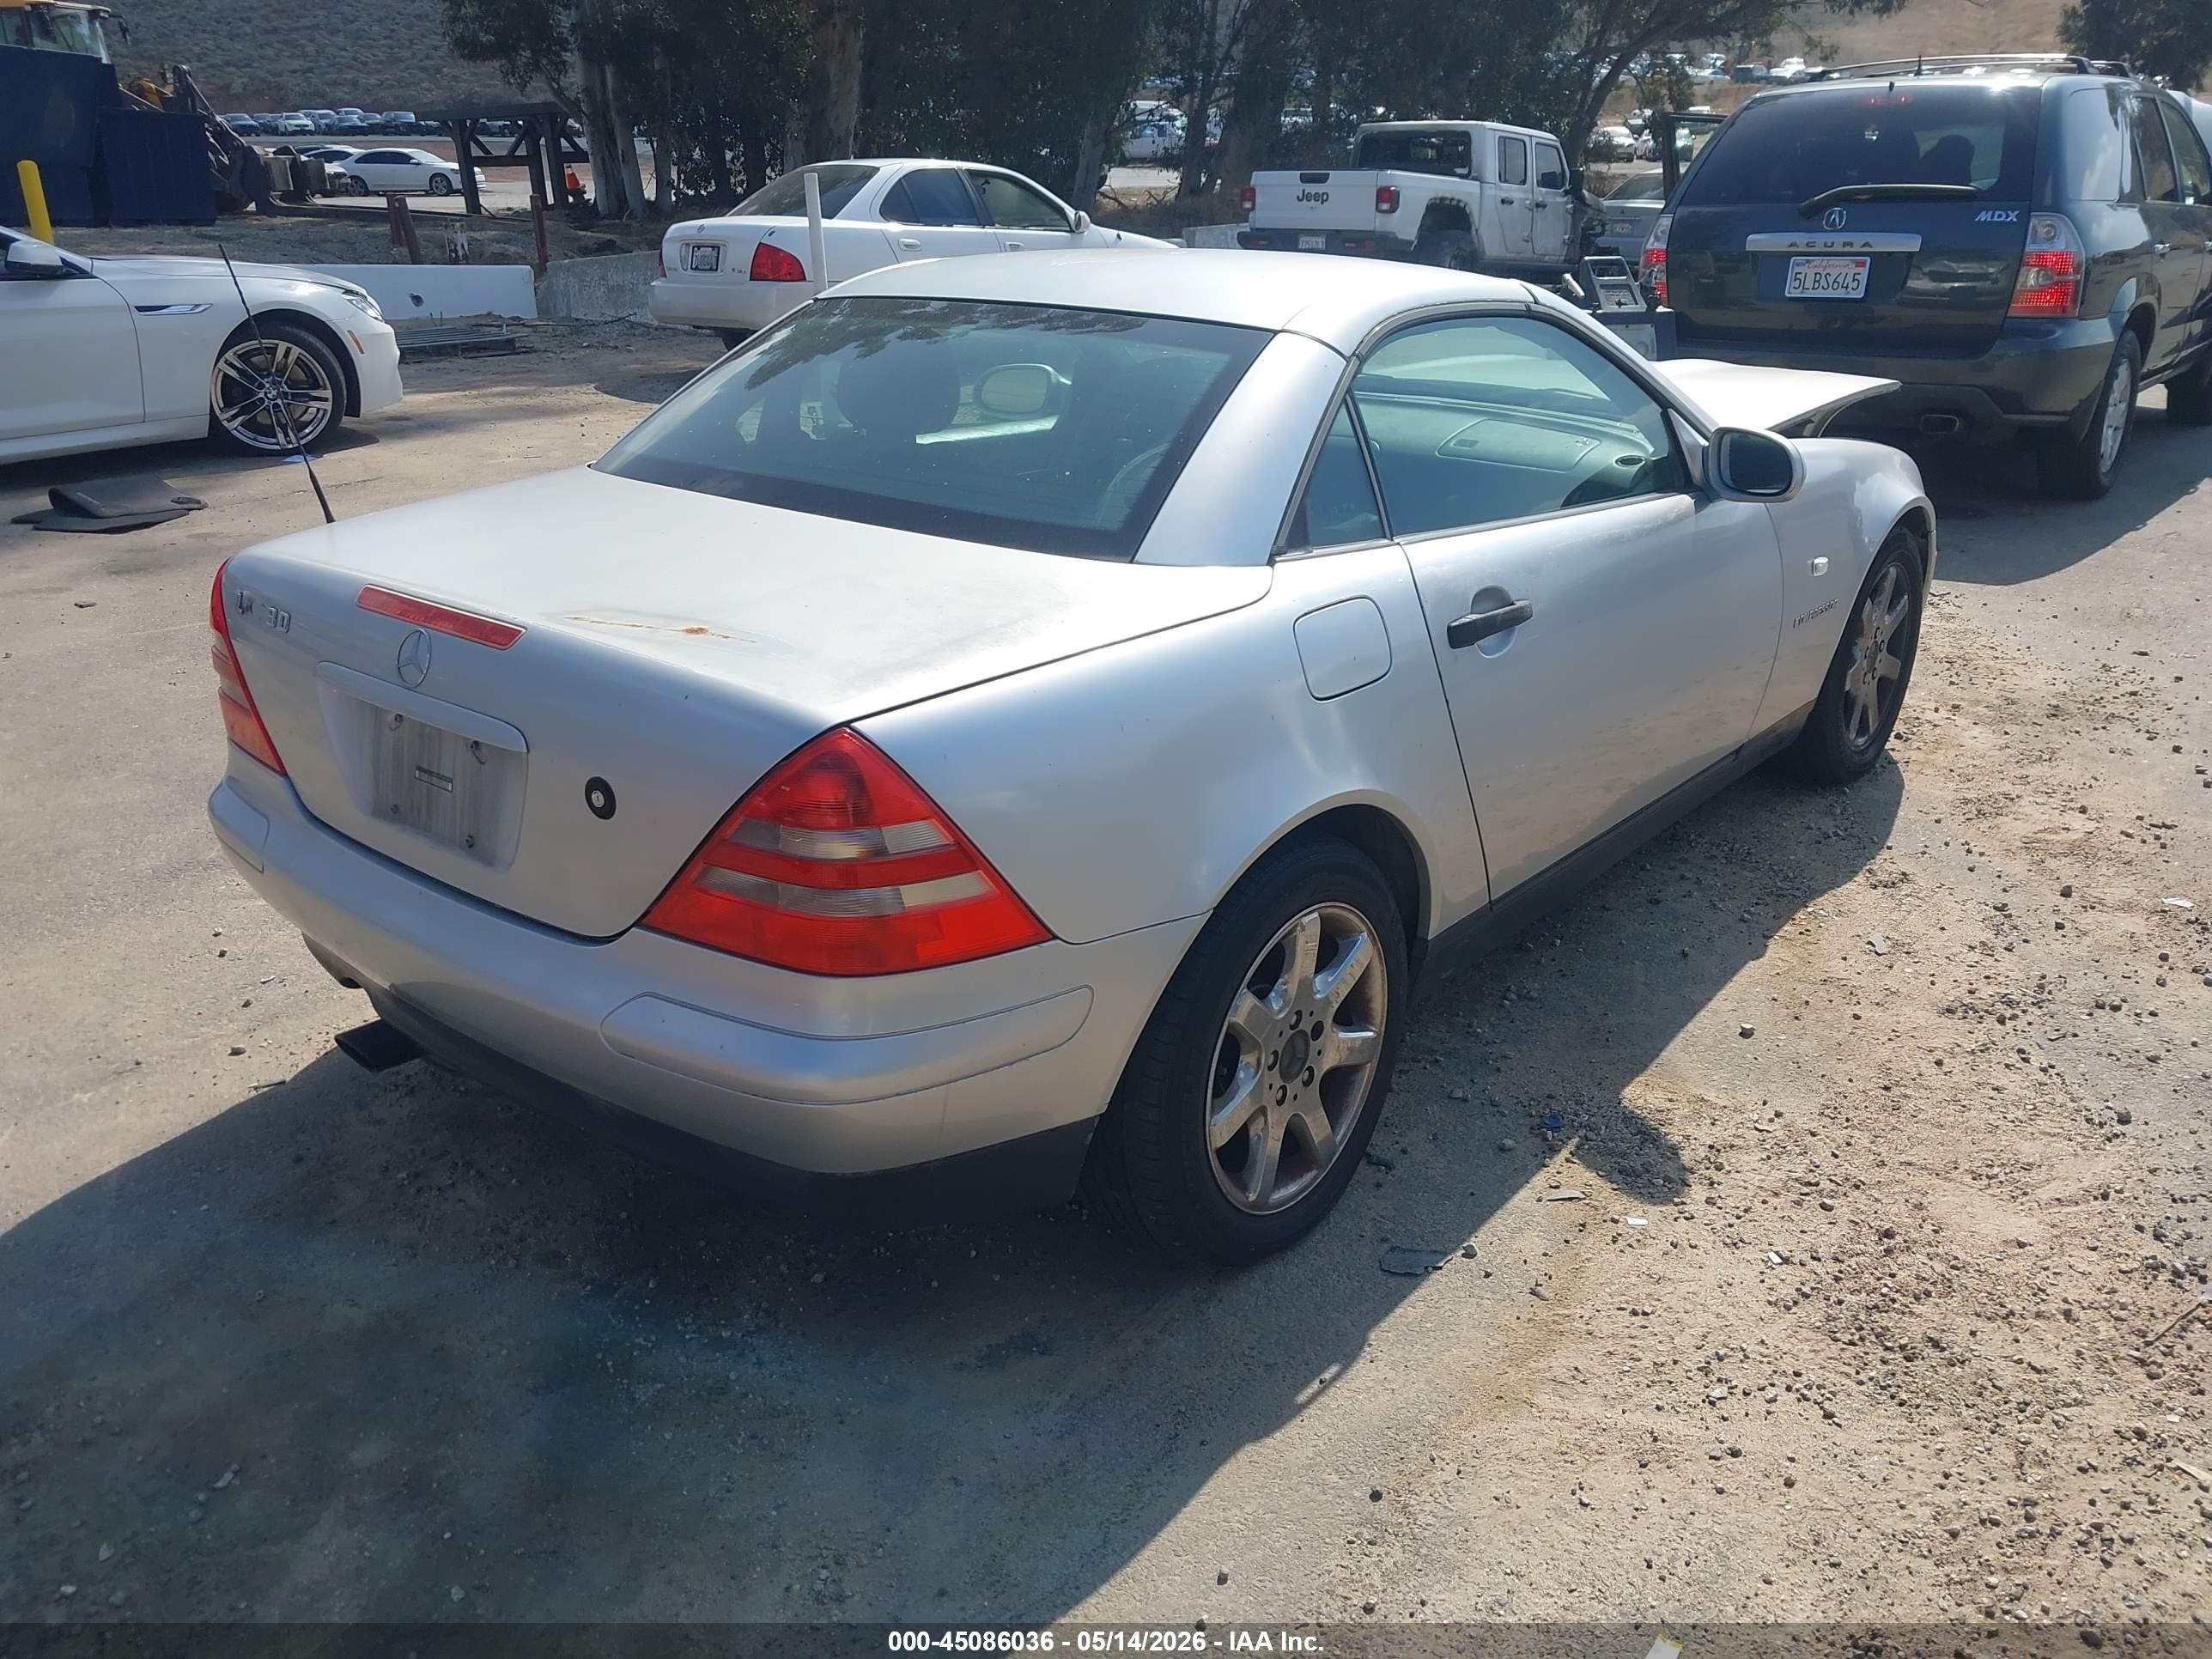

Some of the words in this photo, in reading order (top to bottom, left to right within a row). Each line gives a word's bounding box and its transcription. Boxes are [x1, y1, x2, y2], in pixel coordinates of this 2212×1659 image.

[1297, 188, 1329, 204] Jeep
[1974, 210, 2021, 222] MDX
[1806, 260, 1856, 271] California
[1792, 271, 1862, 291] 5LBS645
